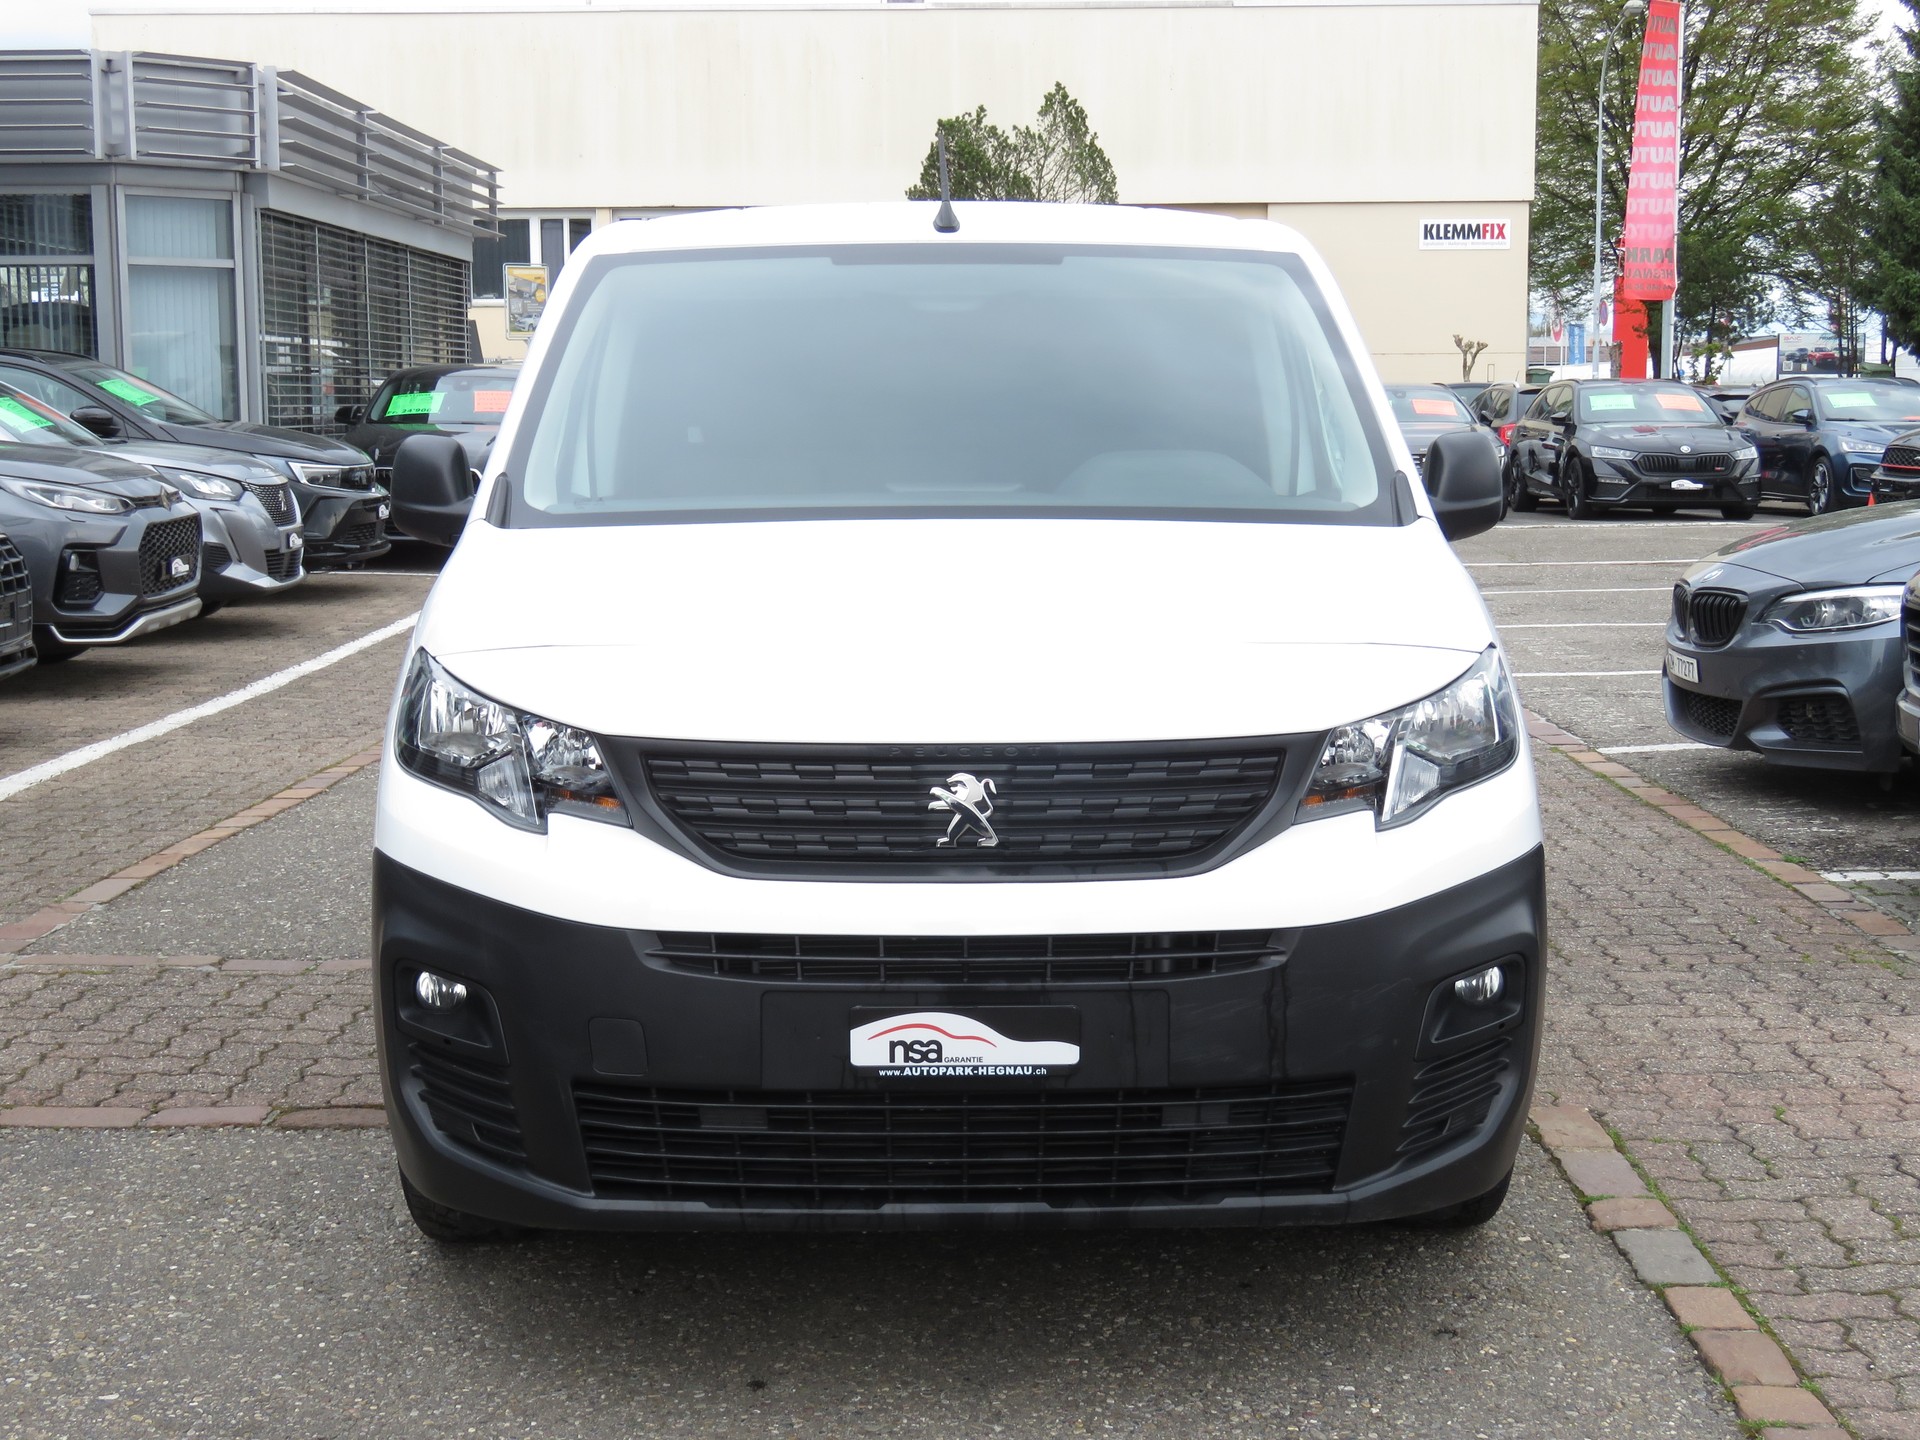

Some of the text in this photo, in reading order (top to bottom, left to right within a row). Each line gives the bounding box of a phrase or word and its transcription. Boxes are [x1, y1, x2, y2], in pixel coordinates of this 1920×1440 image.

[1423, 223, 1506, 240] KLEMMFIX
[888, 746, 1041, 757] PEUGEOT
[889, 1039, 943, 1064] nsa
[878, 1066, 1047, 1076] www.AUTOPARK-HEGNAU.ch
